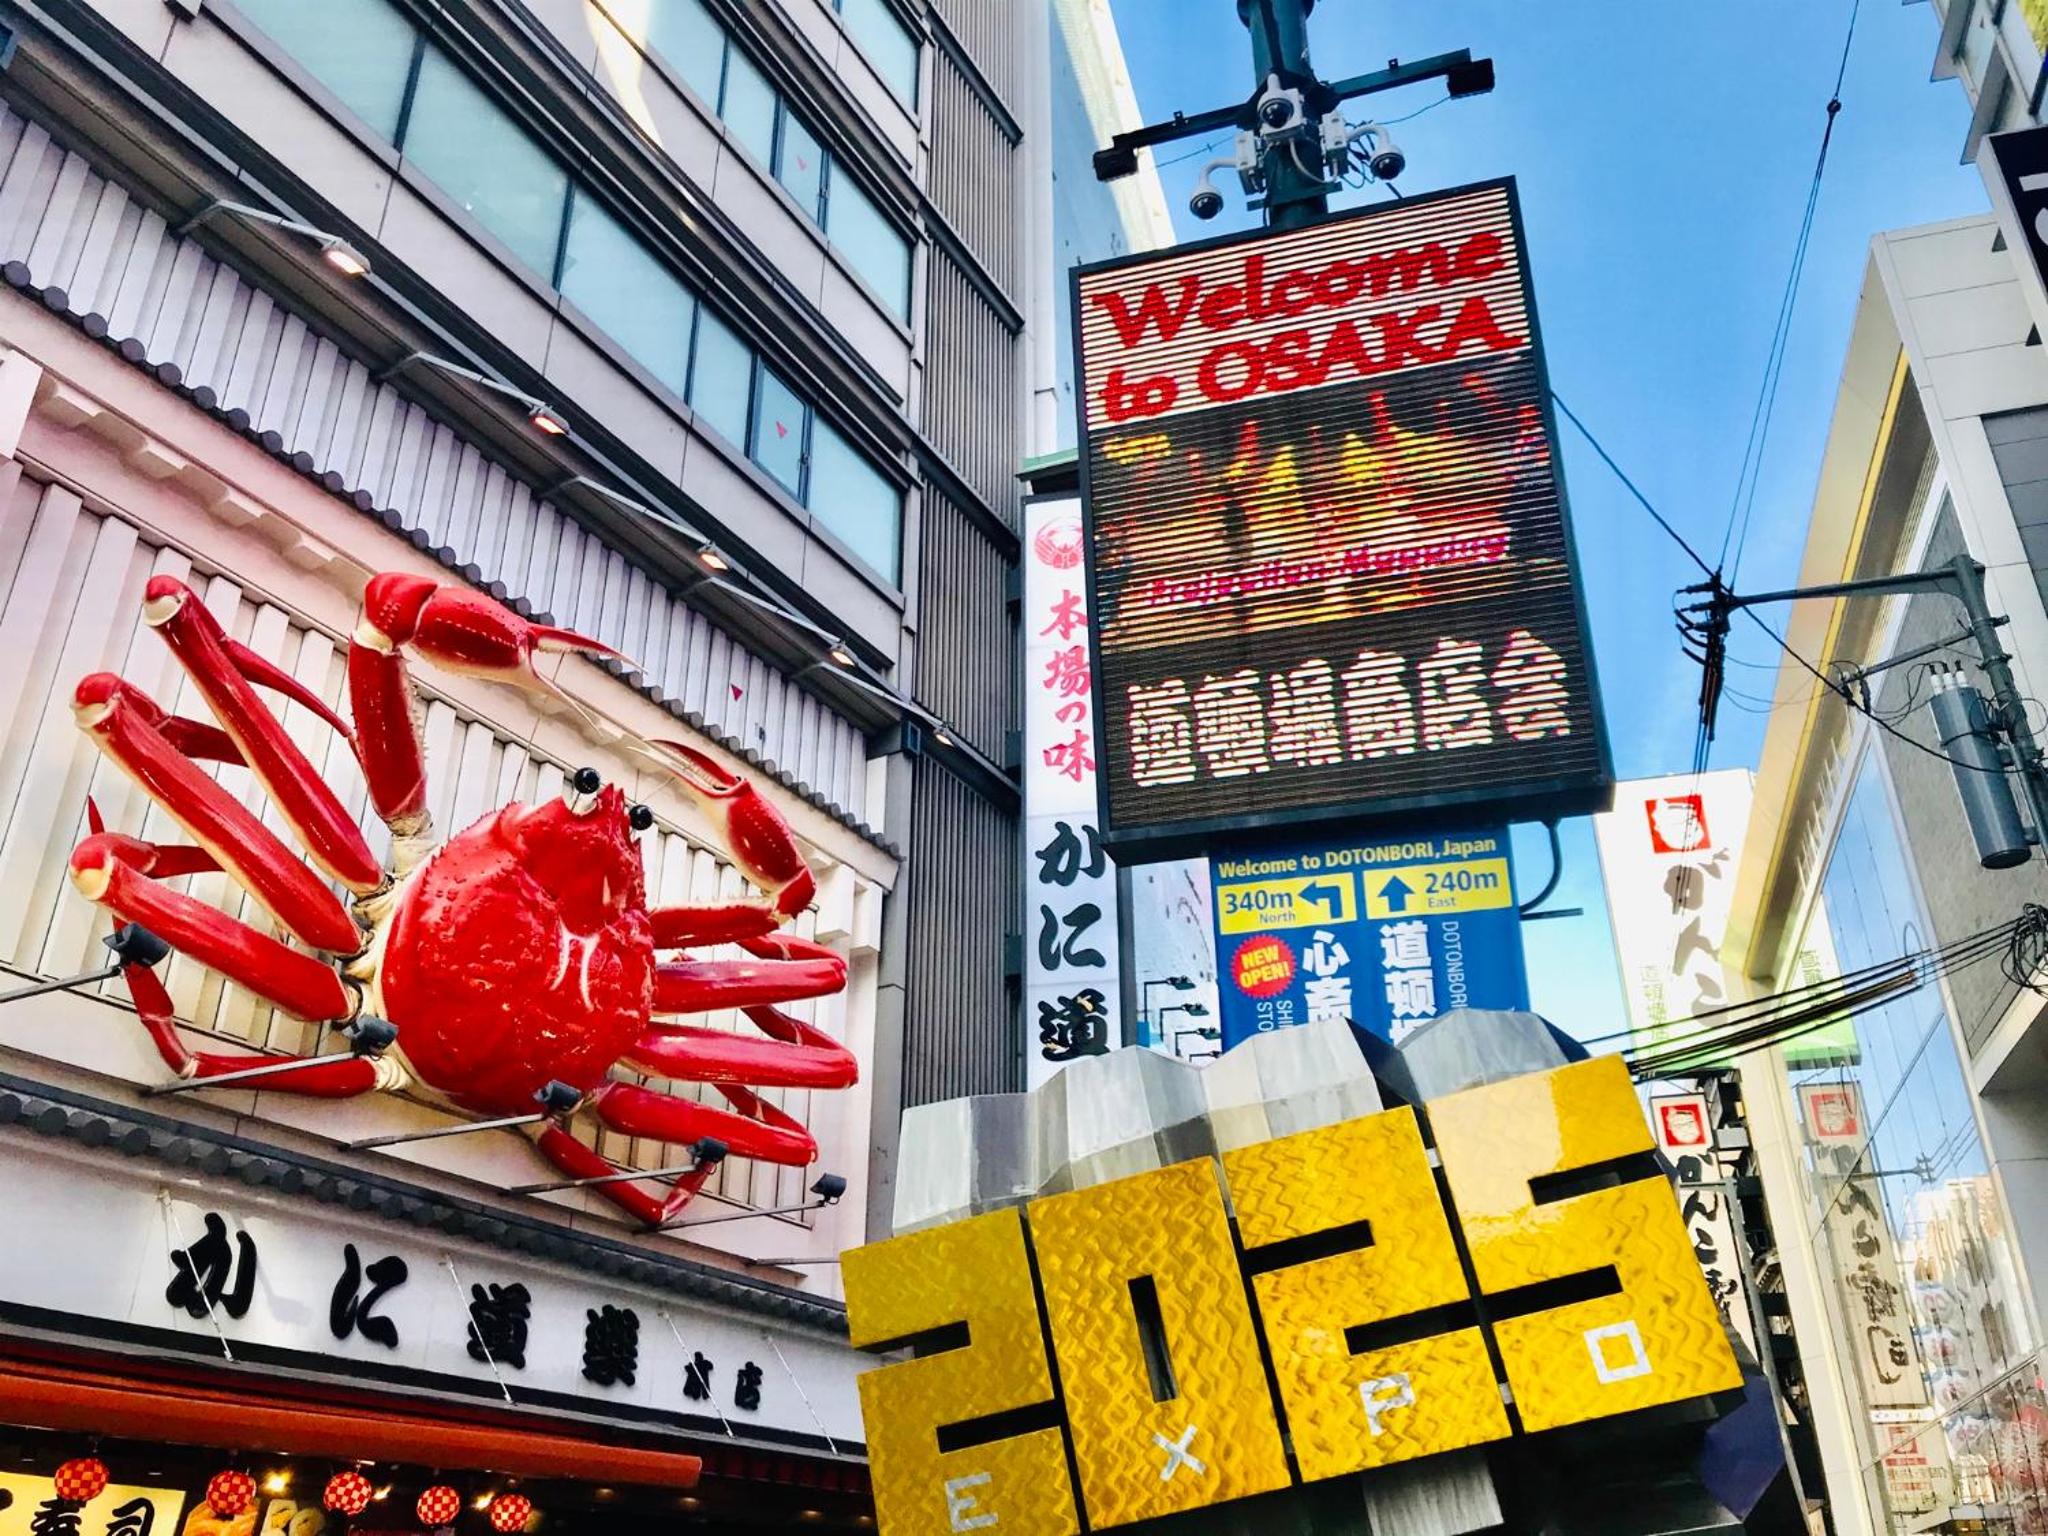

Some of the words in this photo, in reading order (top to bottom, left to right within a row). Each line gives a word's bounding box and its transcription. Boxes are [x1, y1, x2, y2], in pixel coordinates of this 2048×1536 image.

[1093, 232, 1505, 349] Welcome
[1101, 367, 1179, 422] to
[1198, 295, 1524, 402] OSAKA
[1040, 589, 1095, 783] 本場の味
[1127, 628, 1570, 786] 道頓堀商店会
[1217, 858, 1297, 879] Welcome
[1301, 854, 1320, 870] to
[1424, 870, 1499, 895] 240m
[1225, 889, 1294, 914] 340m
[1428, 896, 1457, 909] East
[1258, 910, 1296, 925] North
[1241, 944, 1280, 971] NEW
[1442, 920, 1468, 1008] DOTONBORI
[1239, 960, 1292, 989] OPEN!
[1256, 1001, 1275, 1032] STO
[1276, 1000, 1294, 1028] SHI
[840, 1053, 1745, 1536] 2025
